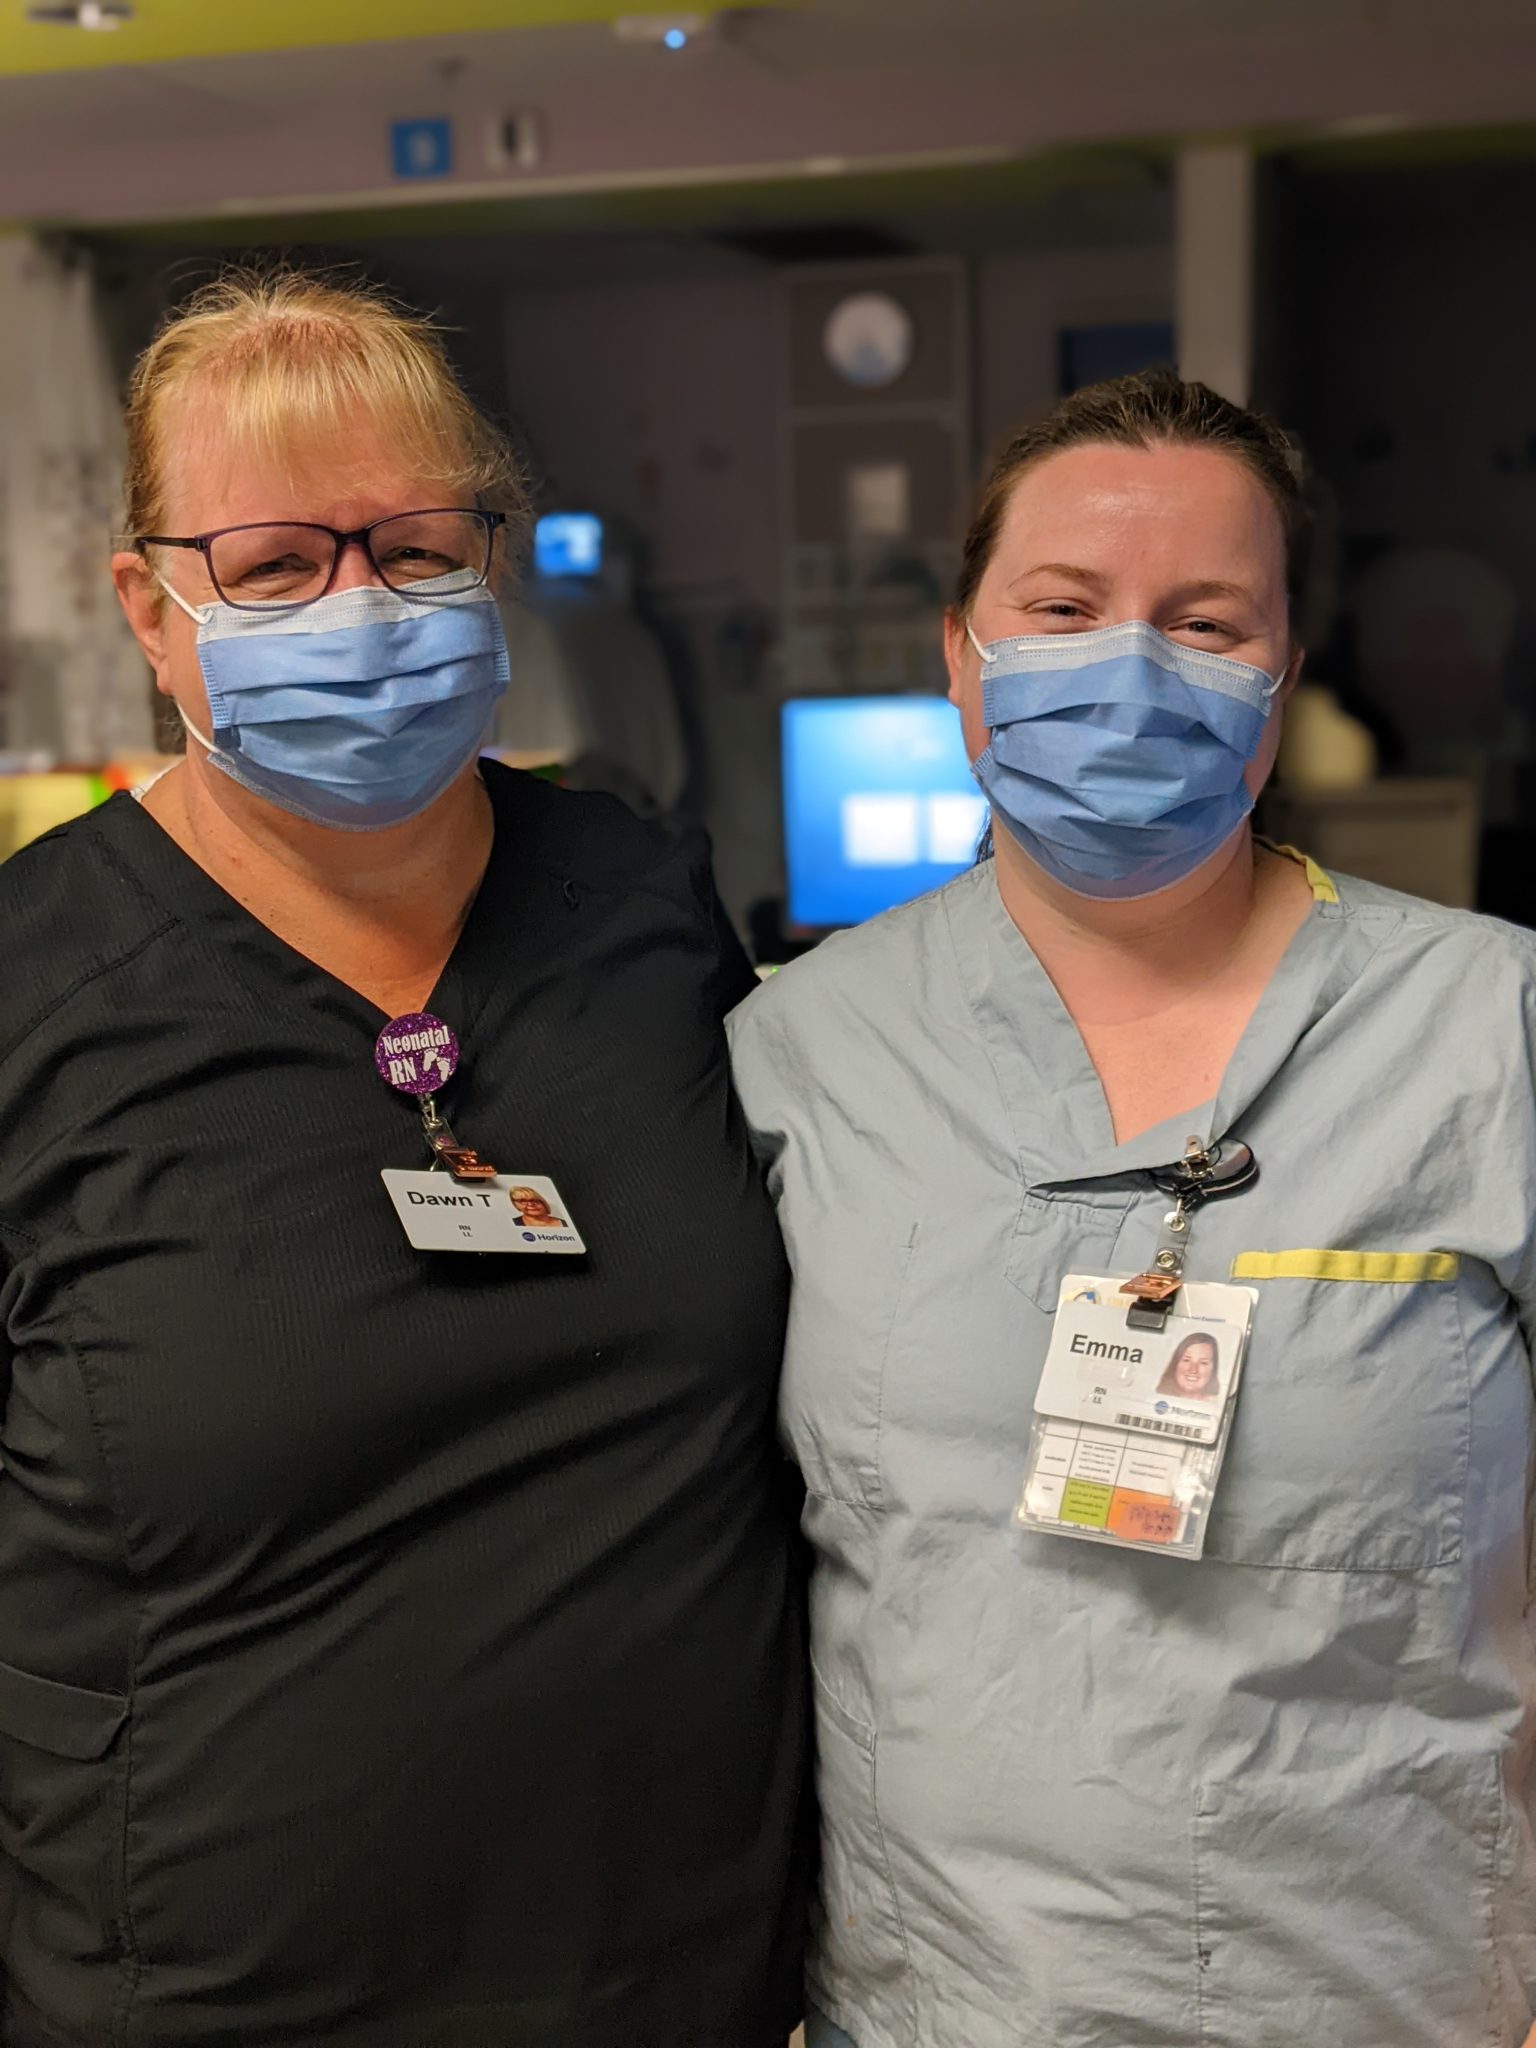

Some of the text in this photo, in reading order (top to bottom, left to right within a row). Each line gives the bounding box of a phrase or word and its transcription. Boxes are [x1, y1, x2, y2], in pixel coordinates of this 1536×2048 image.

[382, 1025, 450, 1056] Neonatal
[388, 1056, 417, 1085] RN
[406, 1190, 491, 1207] Dawn T
[537, 1233, 576, 1242] Horizon
[1069, 1333, 1144, 1364] Emma
[1094, 1386, 1107, 1396] RN
